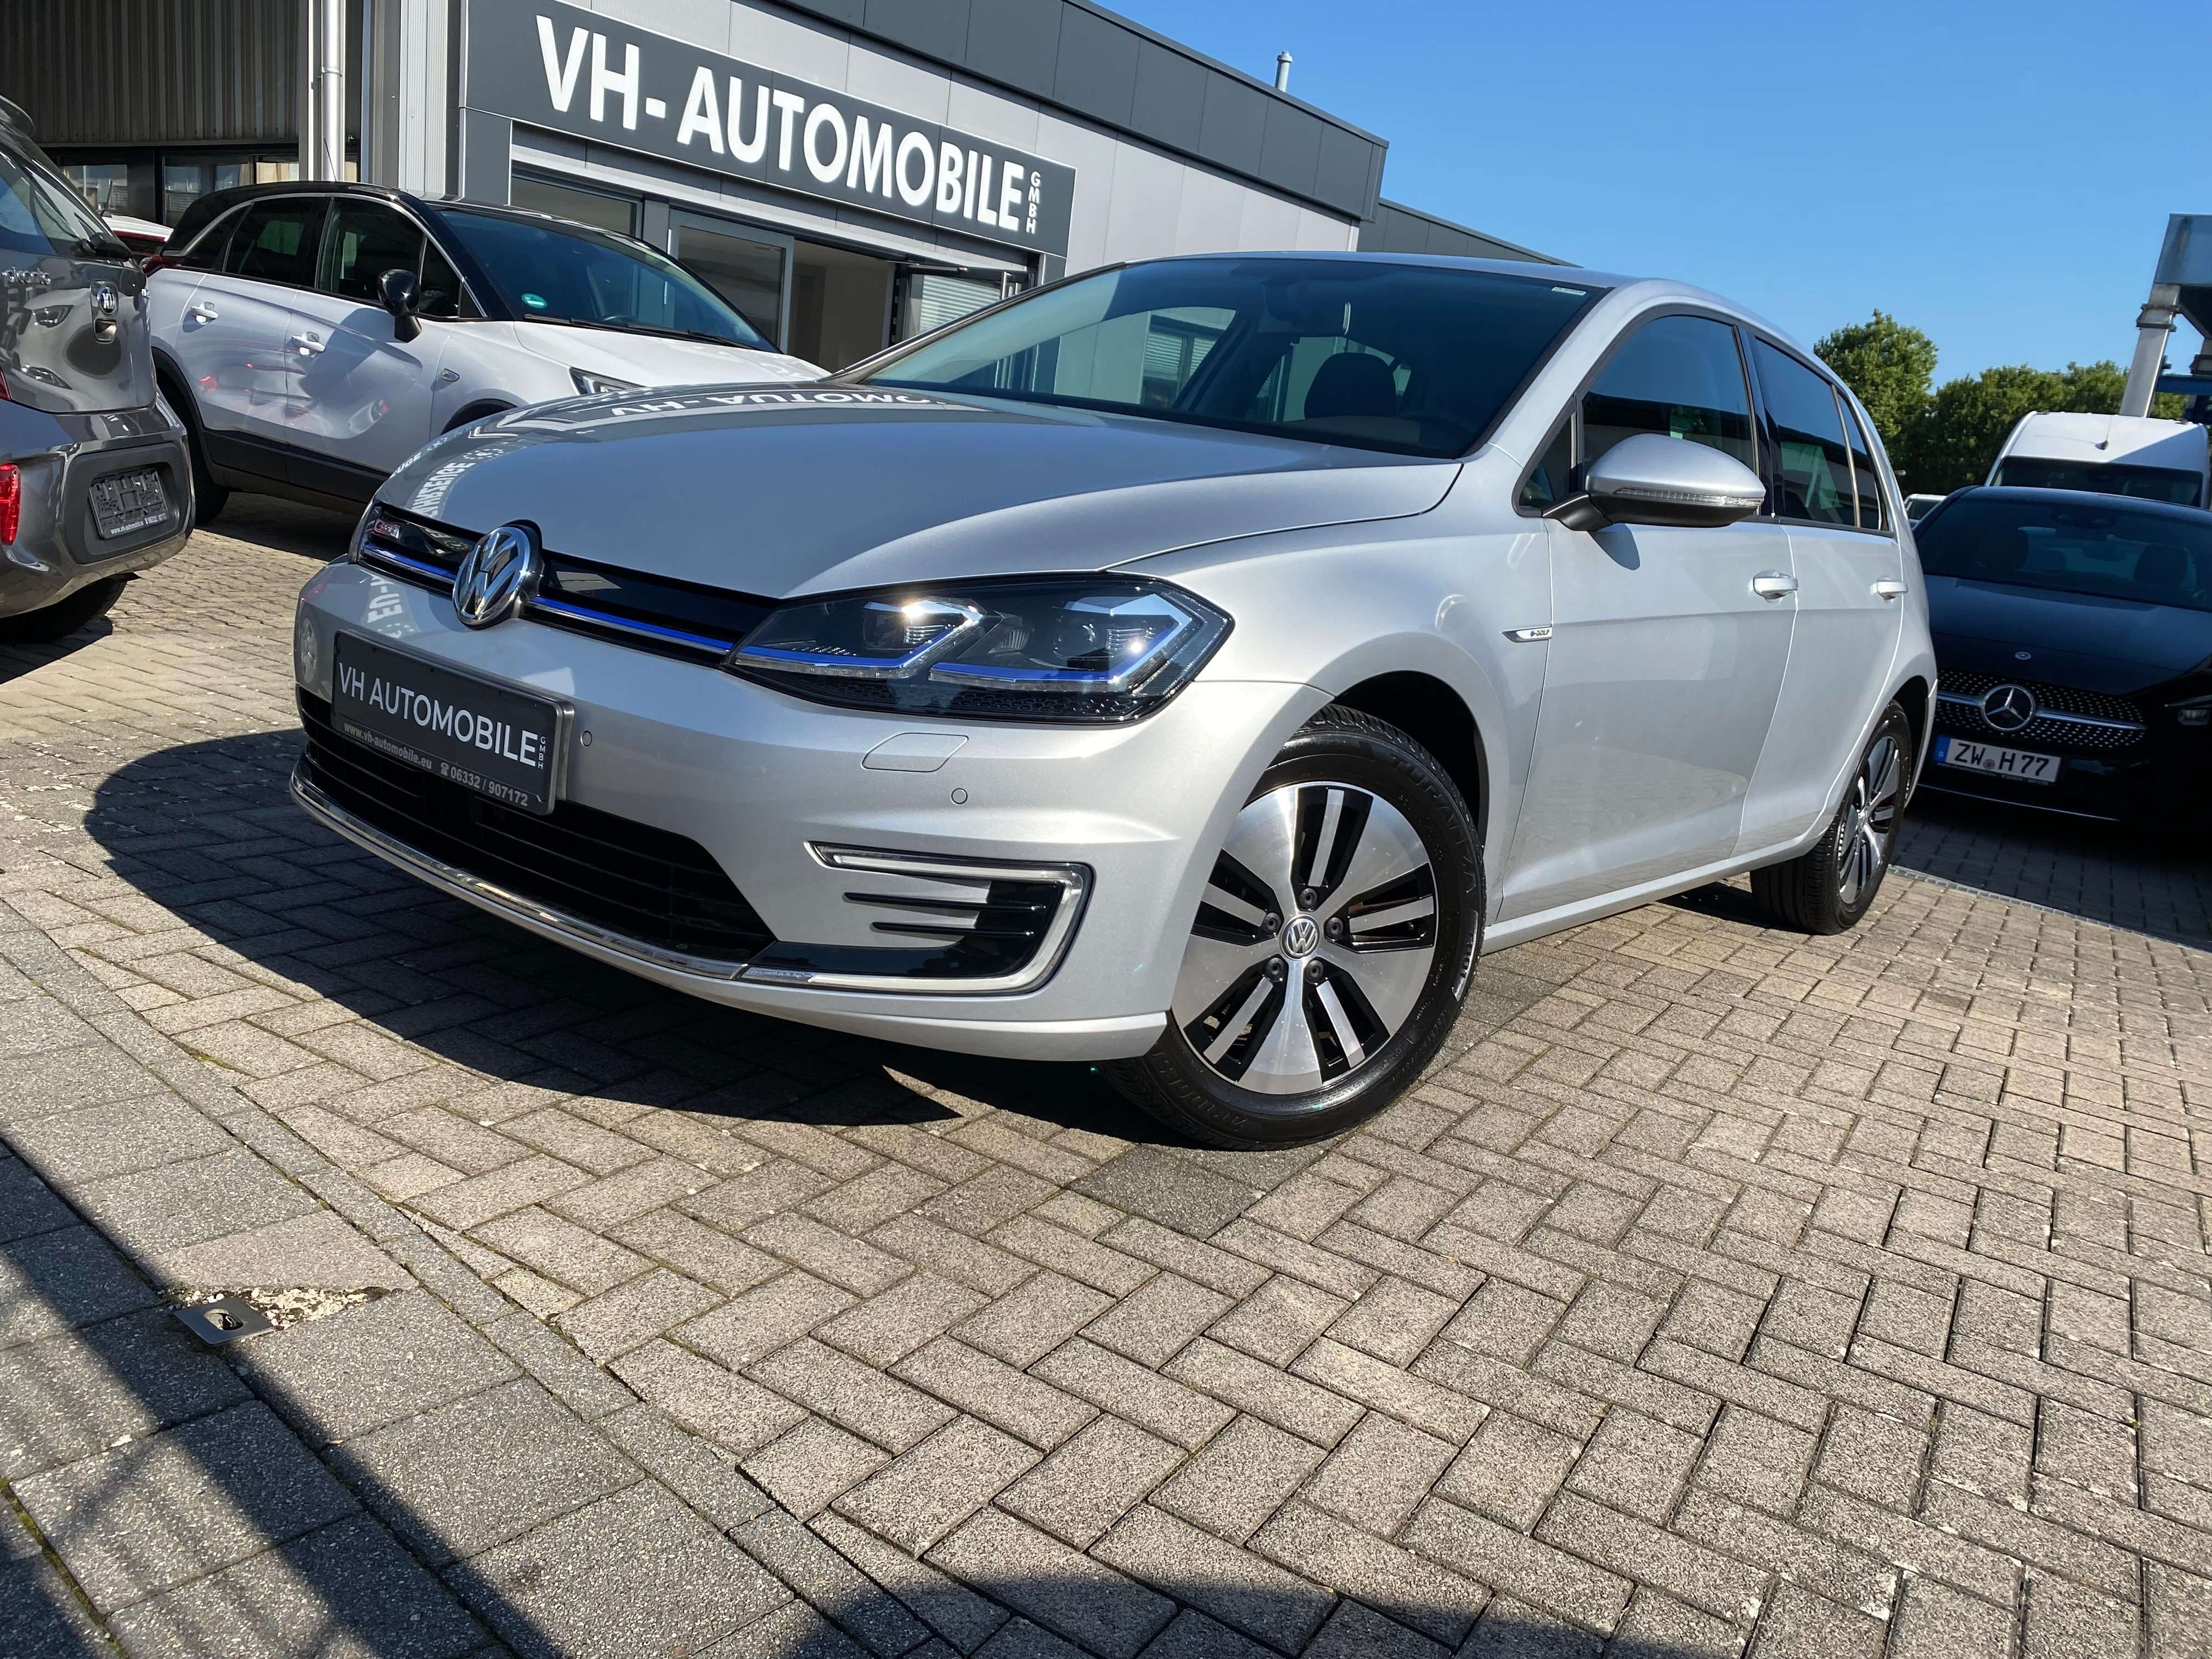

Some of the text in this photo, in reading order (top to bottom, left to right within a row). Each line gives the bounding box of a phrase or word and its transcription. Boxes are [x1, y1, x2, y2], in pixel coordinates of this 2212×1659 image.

[676, 66, 1025, 232] AUTOMOBILE
[1025, 171, 1042, 235] GMBH
[339, 662, 538, 767] VH AUTOMOBILE
[344, 722, 432, 770] www.vh-automobile.eu
[450, 766, 481, 789] 06332
[488, 781, 528, 807] 907172
[538, 736, 546, 770] GMBH
[1954, 742, 1987, 766] ZW
[1998, 751, 2017, 772] H
[2021, 754, 2050, 777] 77
